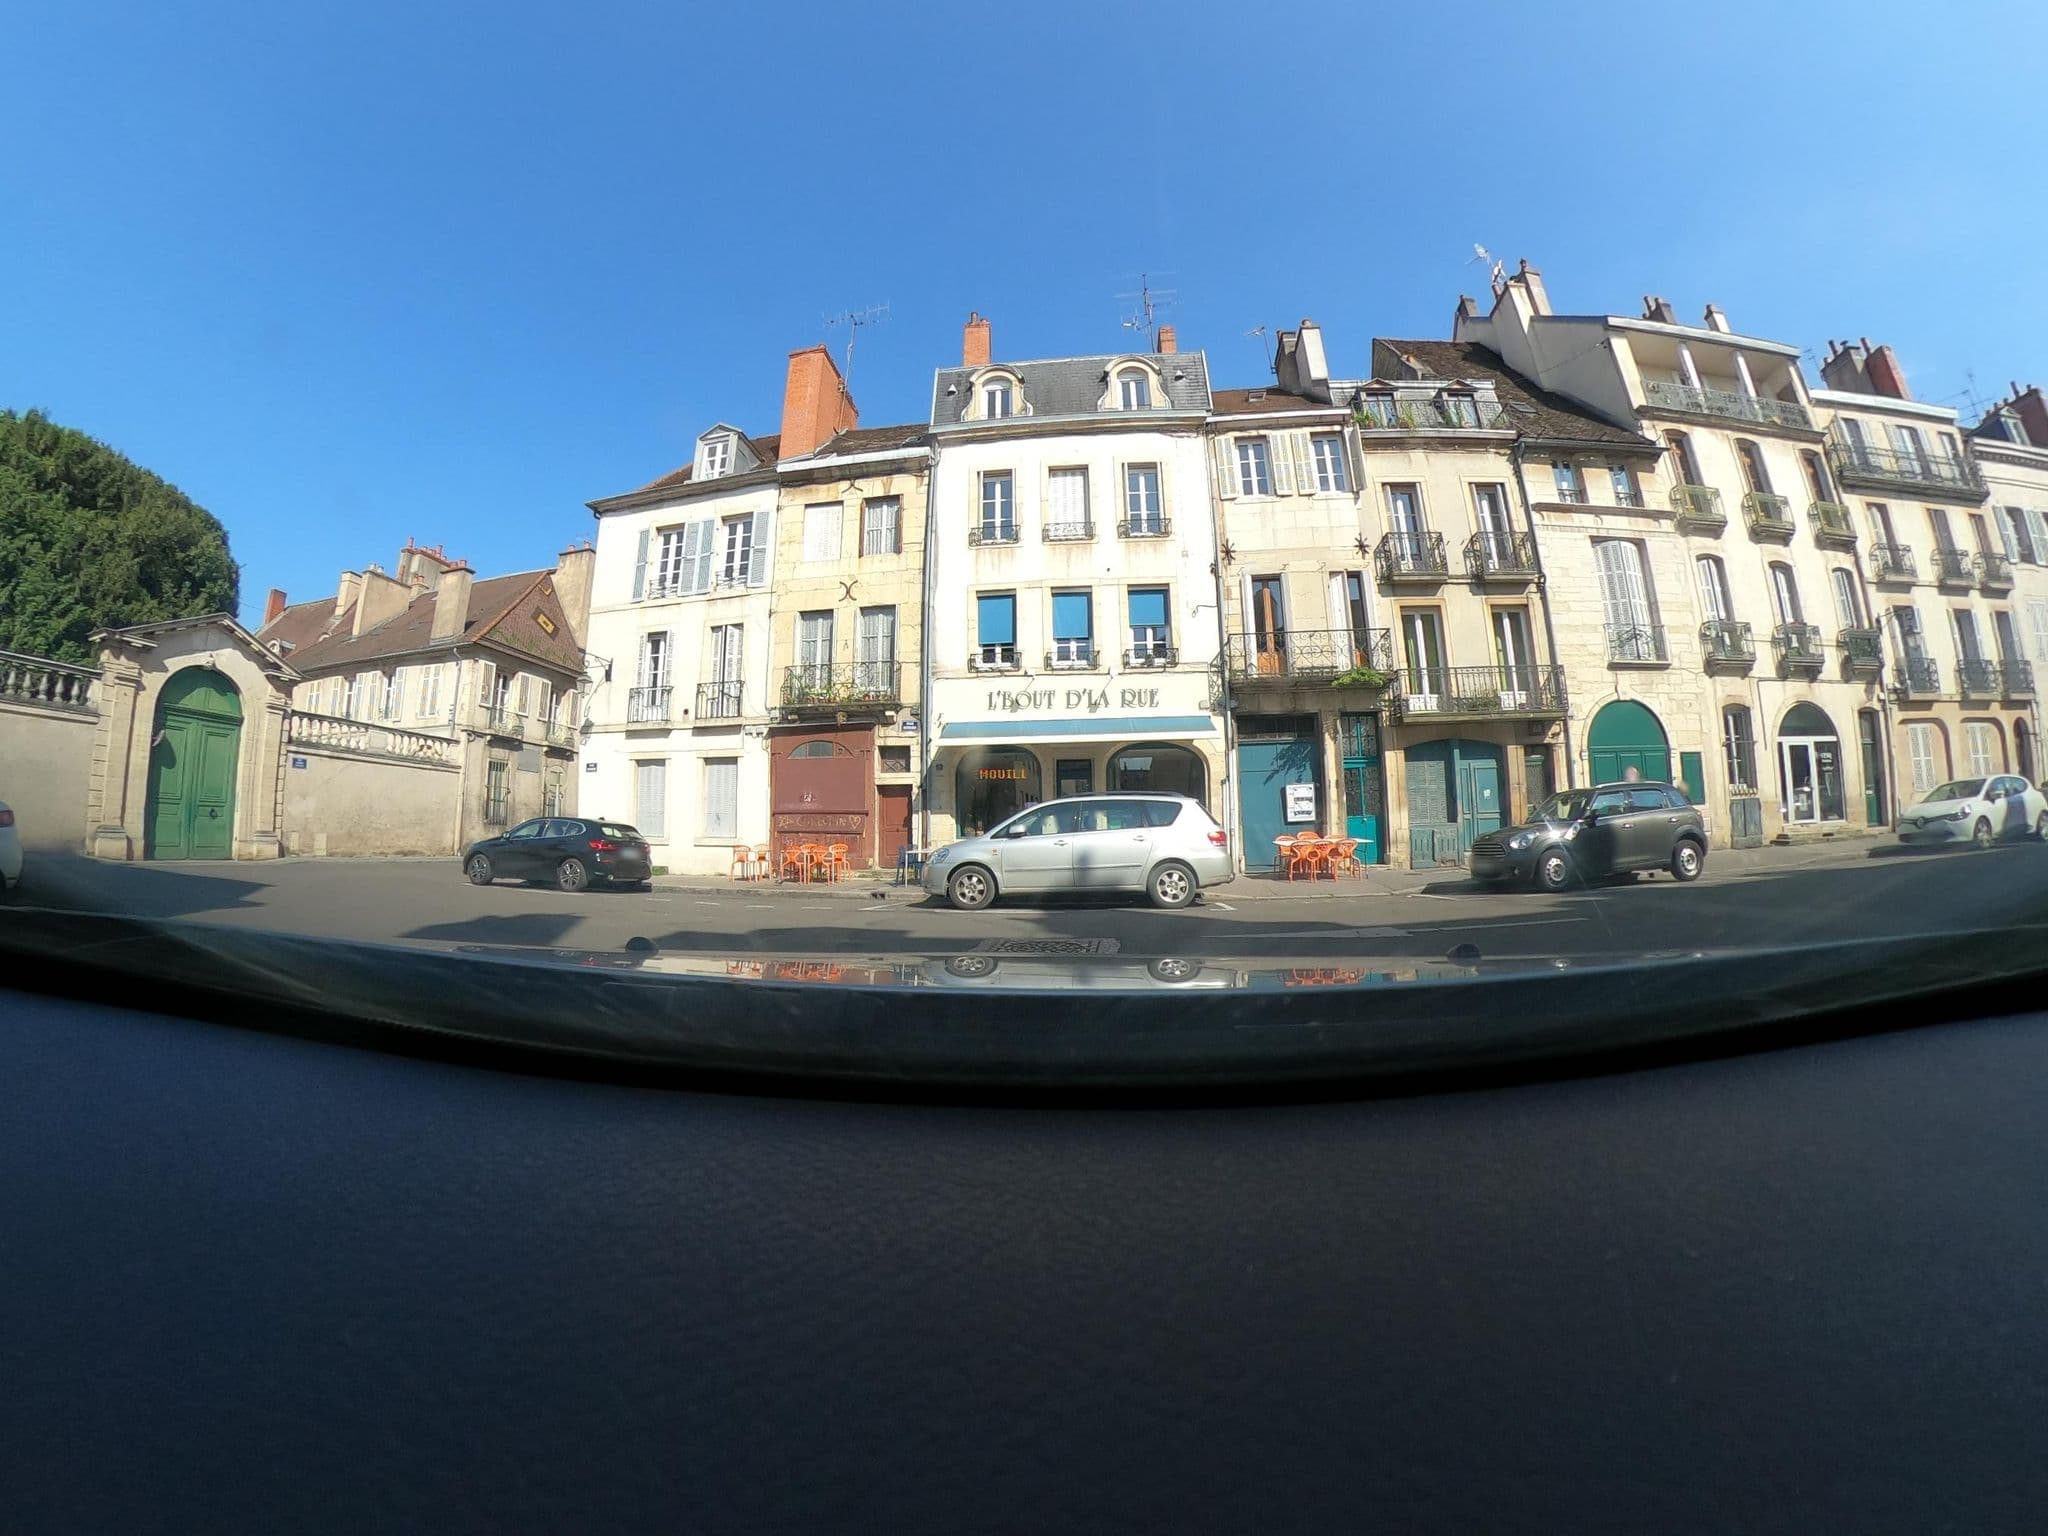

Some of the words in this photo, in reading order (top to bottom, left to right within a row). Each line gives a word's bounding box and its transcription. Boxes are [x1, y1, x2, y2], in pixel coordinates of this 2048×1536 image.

[987, 689, 1056, 711] L'BOUT
[1065, 688, 1110, 709] D'LA
[1120, 688, 1160, 708] RUE
